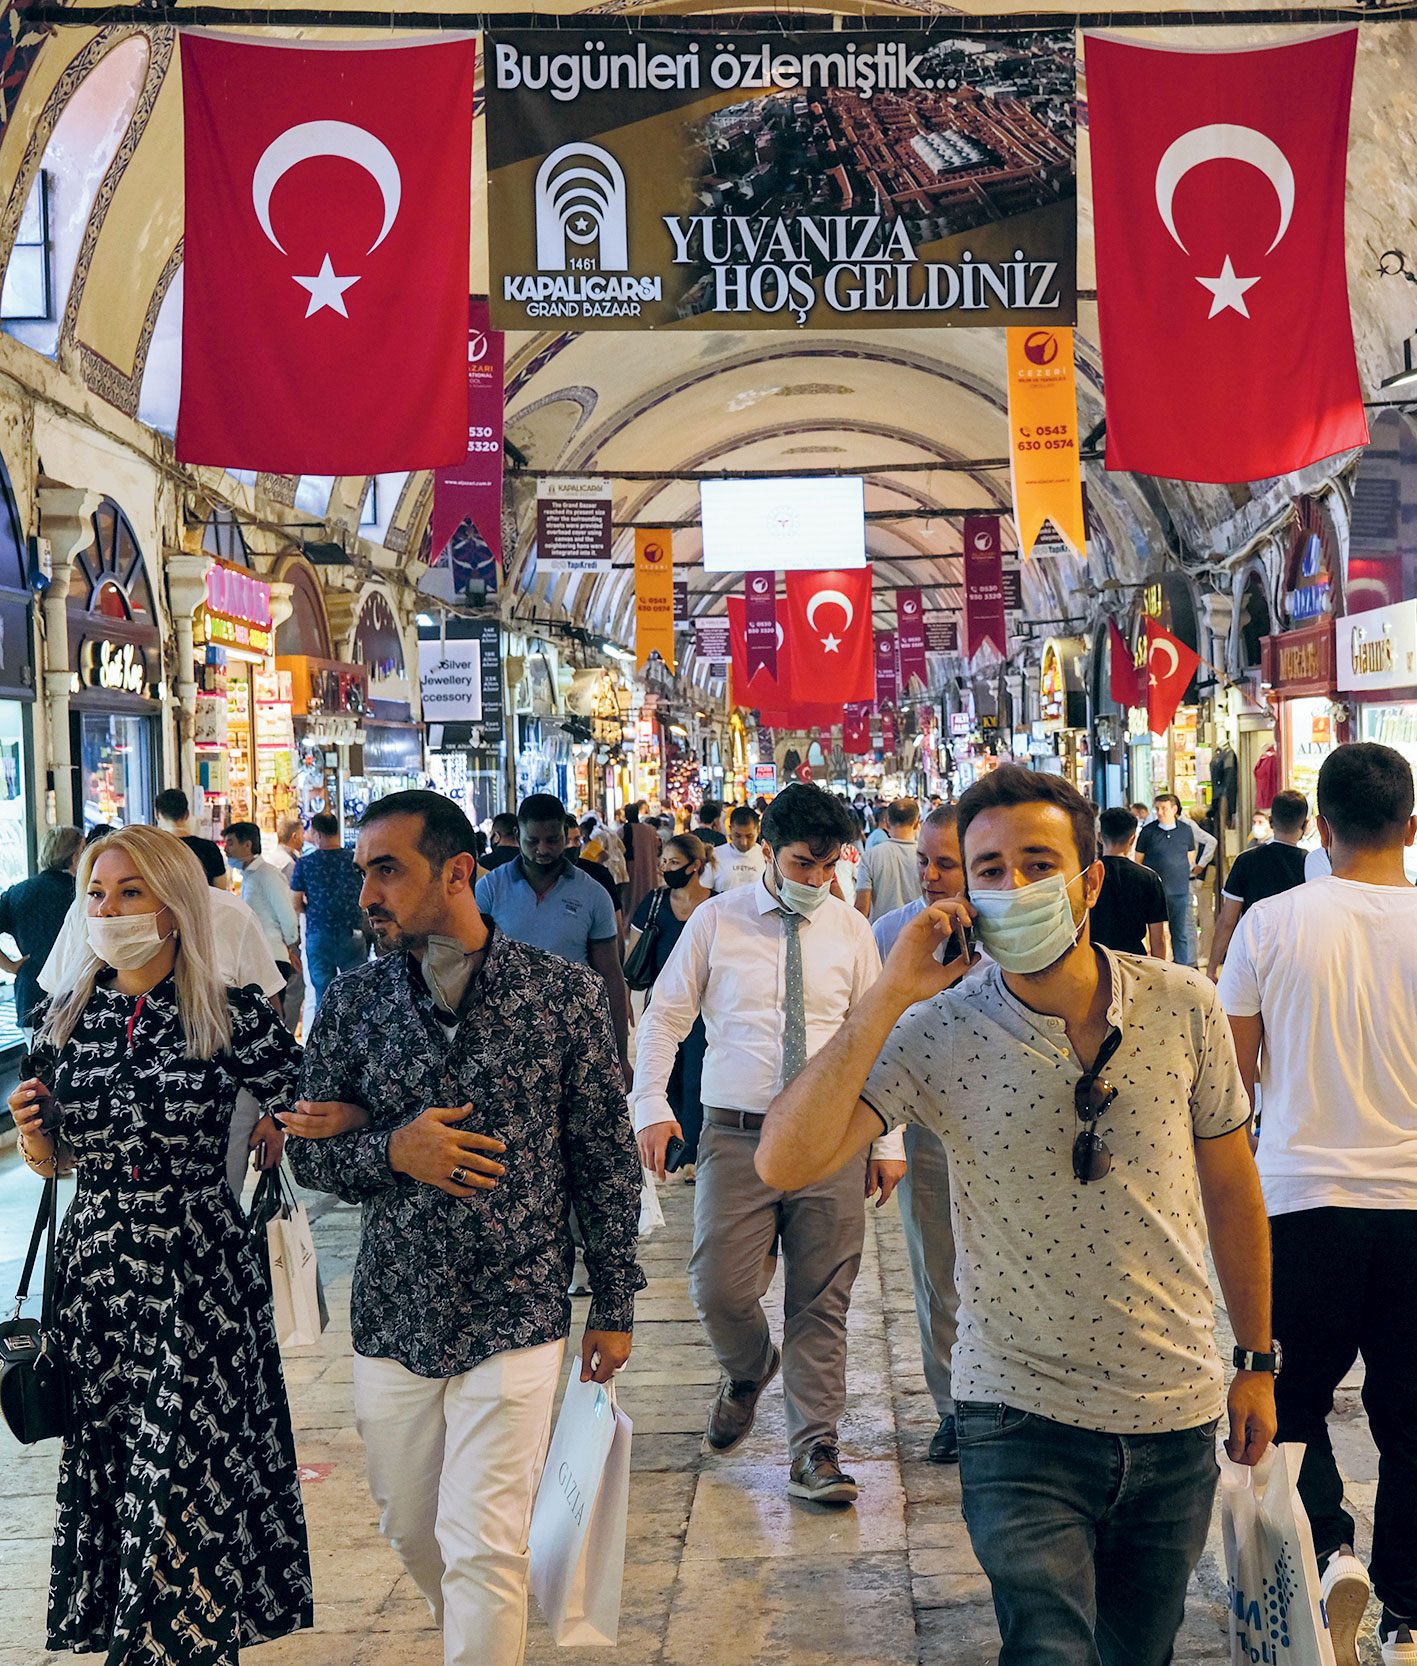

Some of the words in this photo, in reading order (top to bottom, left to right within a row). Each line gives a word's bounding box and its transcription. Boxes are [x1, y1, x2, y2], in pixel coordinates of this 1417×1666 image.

[496, 42, 699, 100] Bugünleri
[711, 42, 957, 100] özlemiştik...
[663, 215, 918, 263] YUVANIZA
[570, 257, 596, 270] 1461
[711, 265, 814, 323] HOŞ
[824, 250, 1059, 311] GELDİNİZ
[526, 302, 579, 317] GRAND
[582, 302, 640, 317] BAZAAR
[469, 427, 493, 437] 530
[1036, 425, 1067, 436] 0543
[1018, 441, 1041, 451] 630
[1045, 439, 1073, 450] 0574
[442, 660, 472, 670] Silver
[422, 675, 472, 686] Jewellery
[423, 692, 473, 703] ccessory
[558, 1461, 585, 1526] GIZIA
